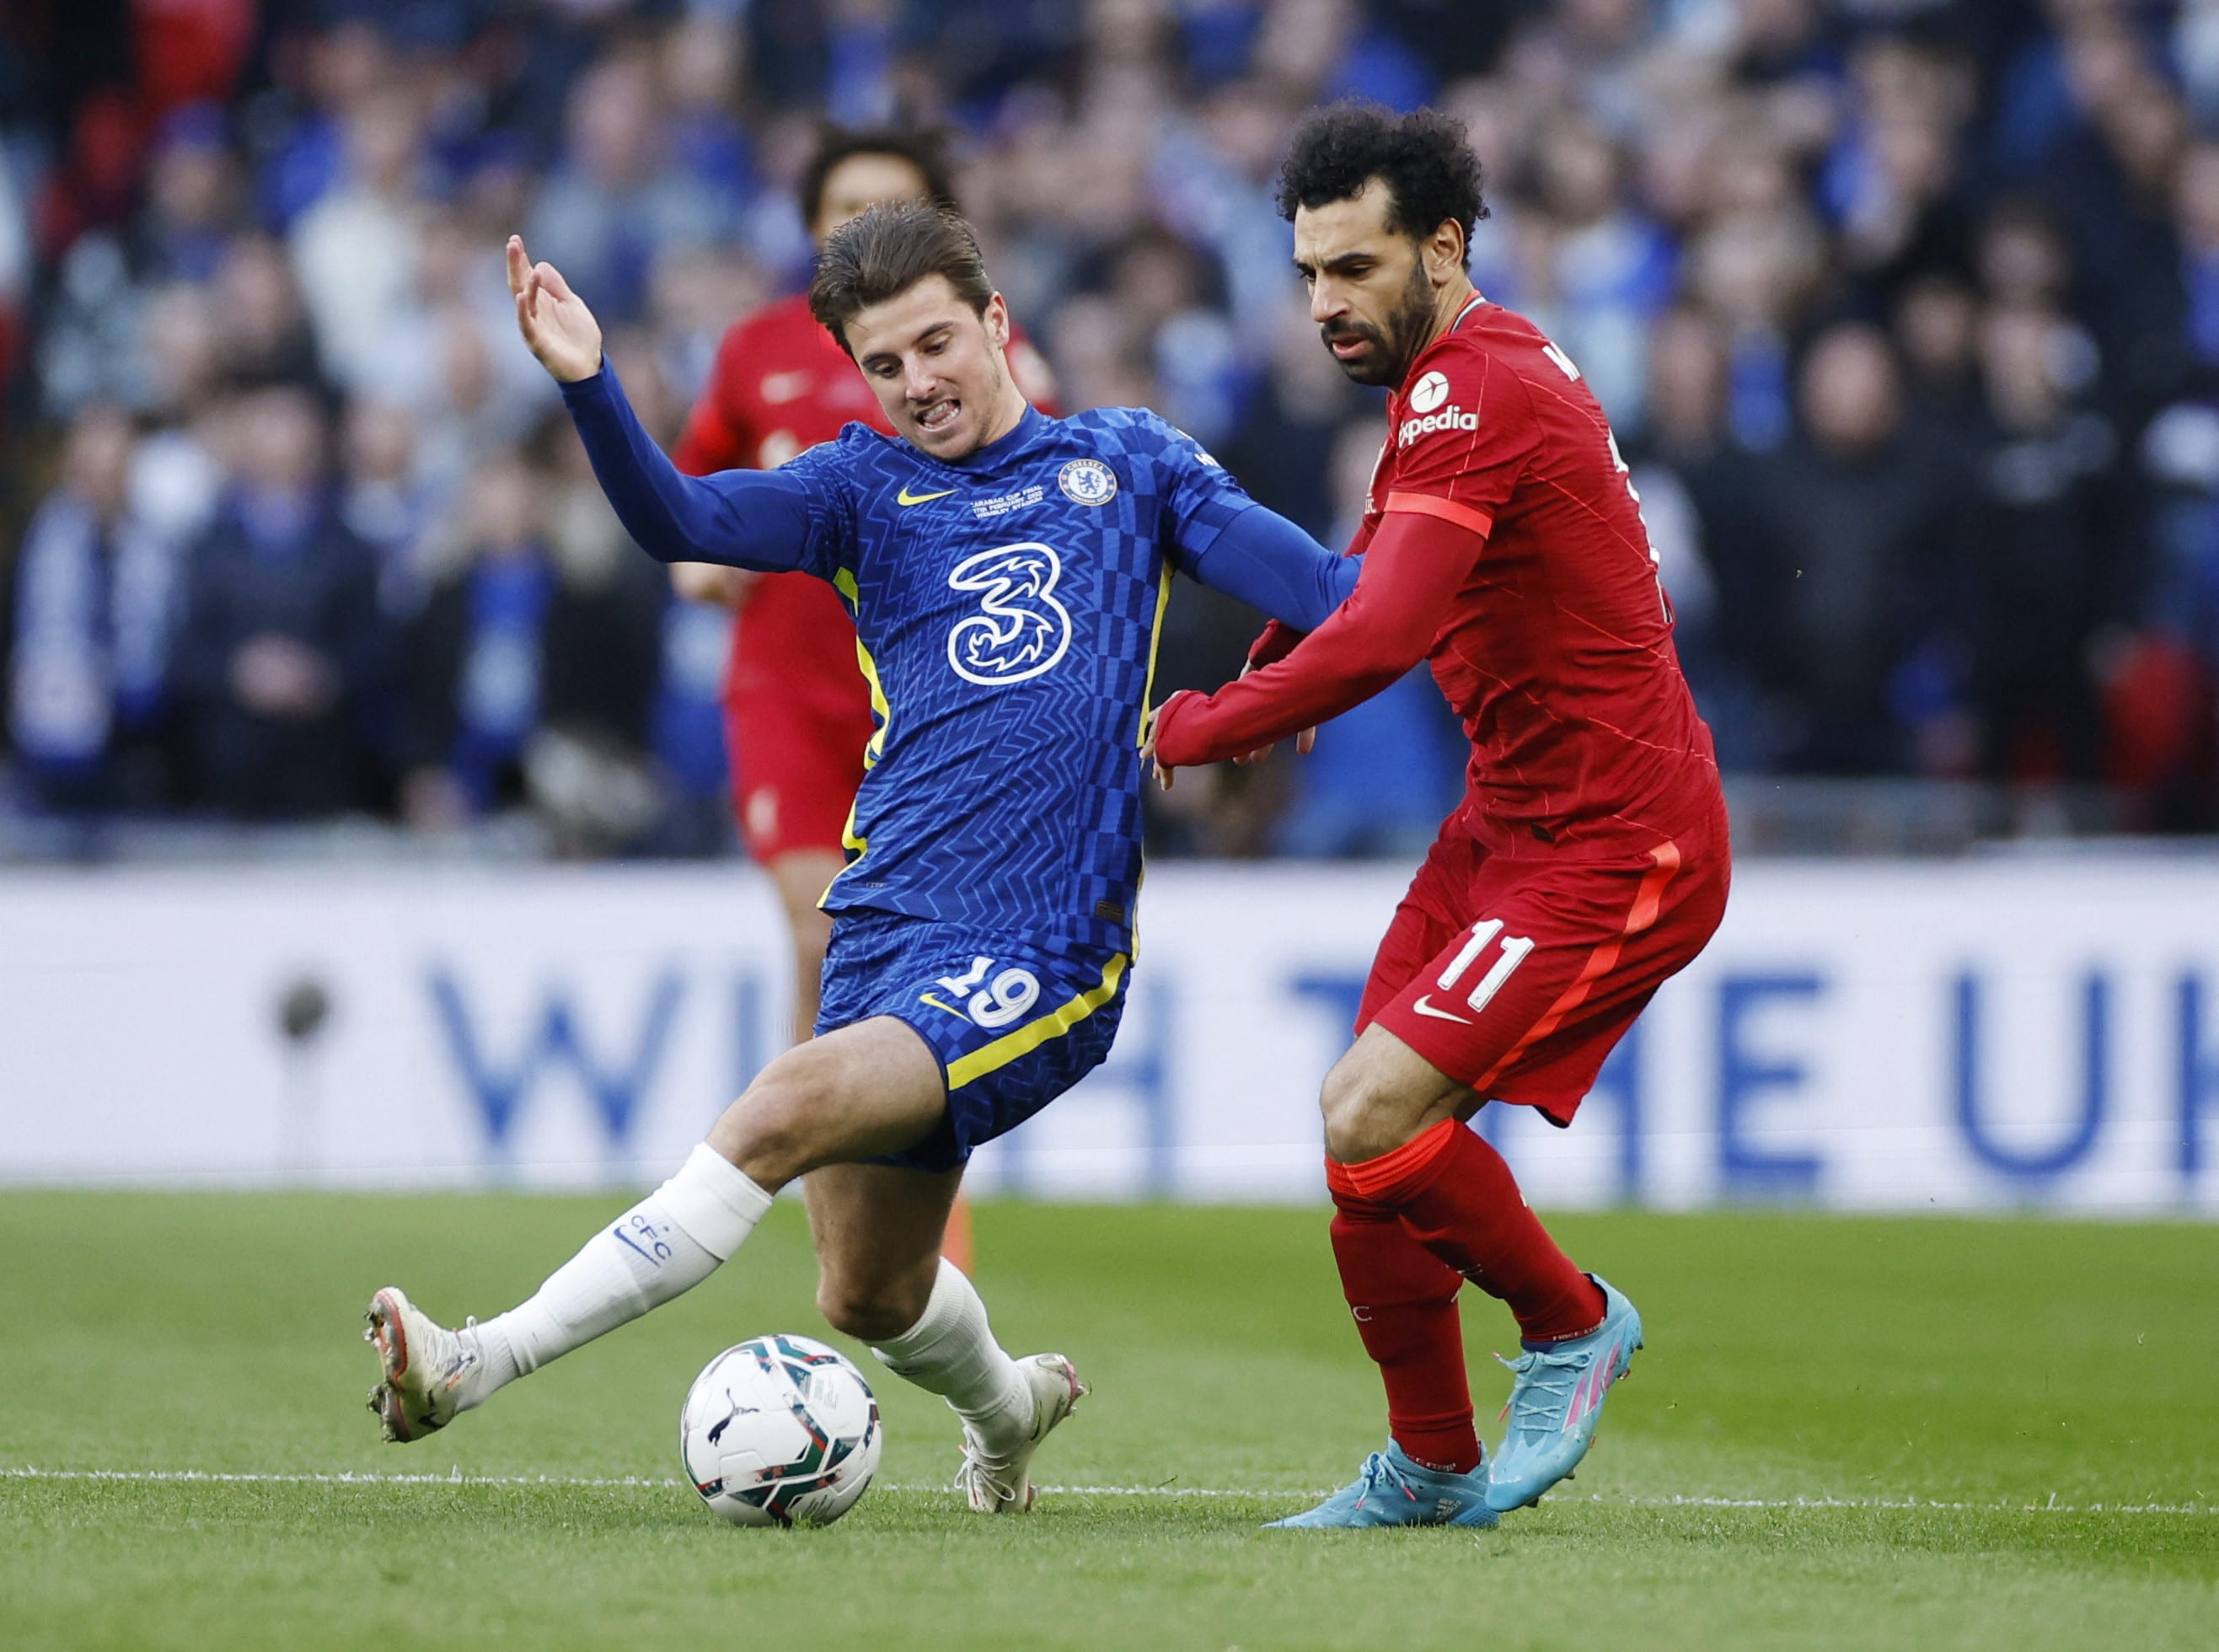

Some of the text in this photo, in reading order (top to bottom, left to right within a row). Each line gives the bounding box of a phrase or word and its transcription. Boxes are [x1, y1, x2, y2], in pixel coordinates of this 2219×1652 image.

[1066, 460, 1104, 471] CHELSEA
[989, 496, 1025, 511] FEBRUARY
[1006, 491, 1021, 501] CUP
[1022, 485, 1043, 496] FINAL
[947, 542, 1072, 685] 3
[1437, 918, 1535, 1012] 11
[631, 1215, 672, 1260] CFC
